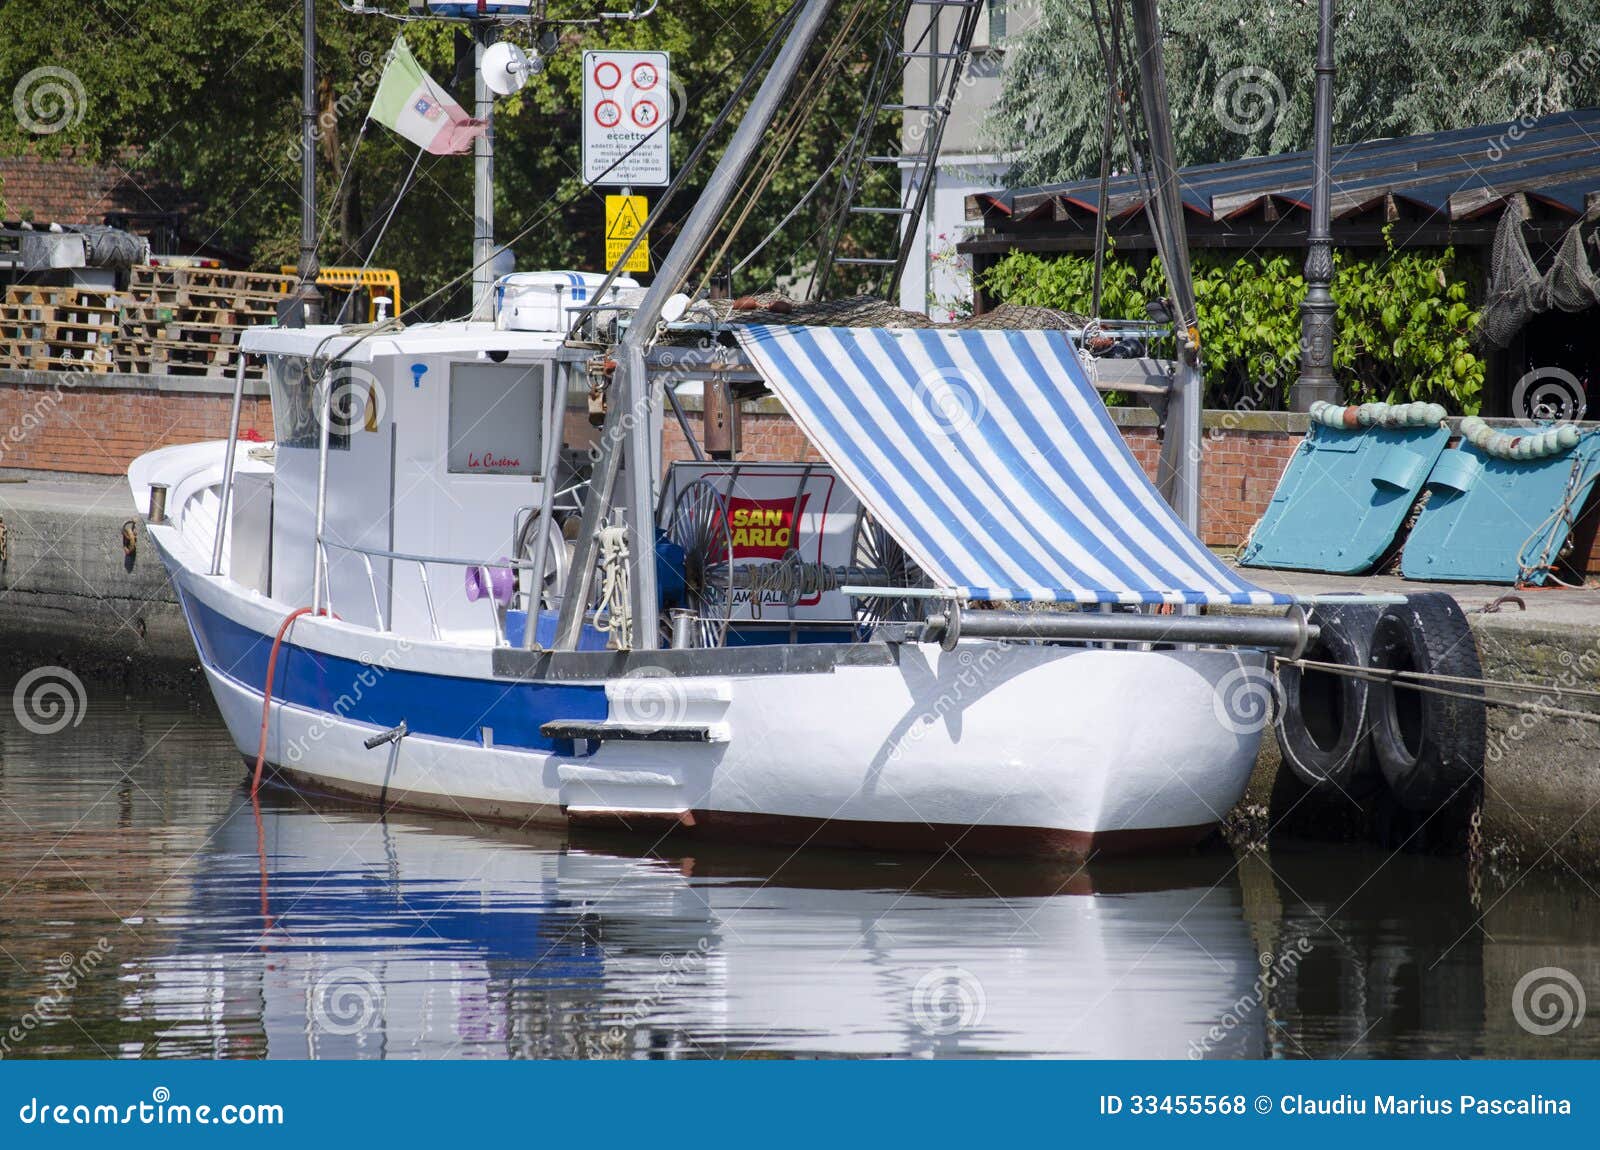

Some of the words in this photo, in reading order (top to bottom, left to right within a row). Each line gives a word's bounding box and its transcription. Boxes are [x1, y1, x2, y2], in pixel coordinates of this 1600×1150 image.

[606, 131, 646, 141] eccetto
[468, 452, 480, 468] La
[732, 508, 783, 527] SAN
[723, 527, 792, 547] ARLO
